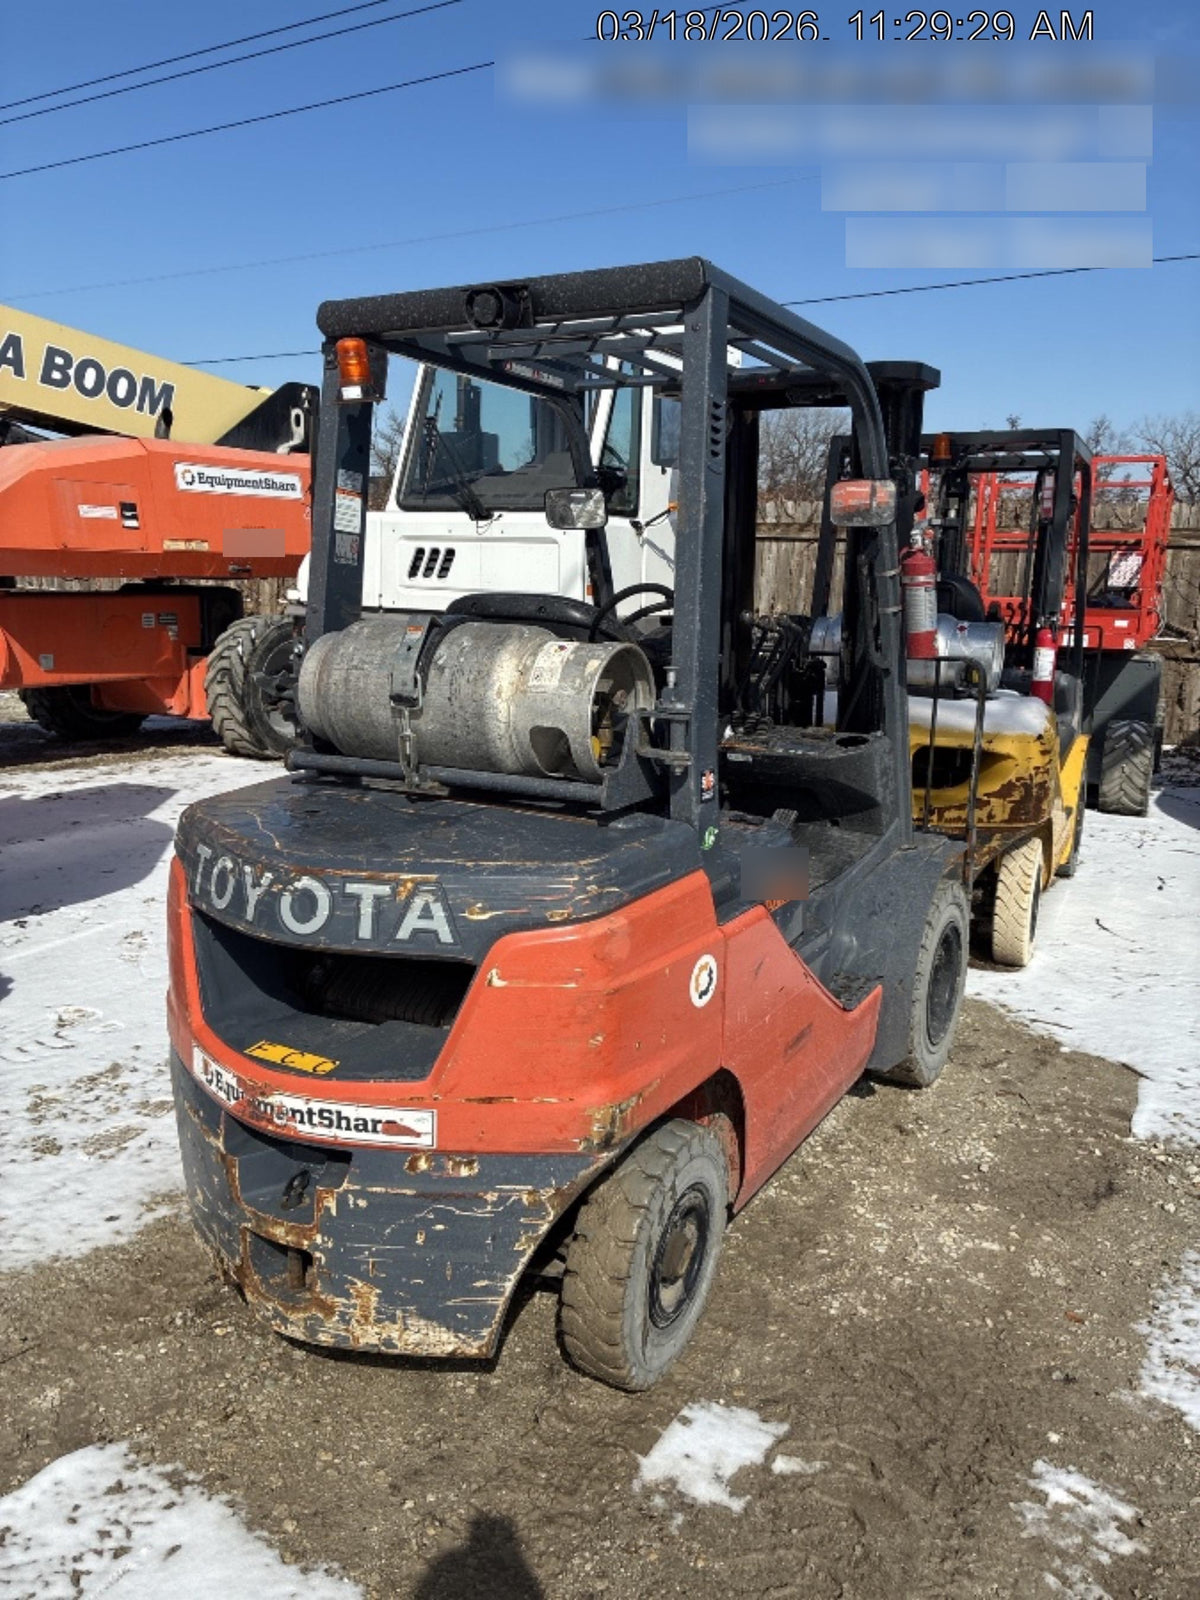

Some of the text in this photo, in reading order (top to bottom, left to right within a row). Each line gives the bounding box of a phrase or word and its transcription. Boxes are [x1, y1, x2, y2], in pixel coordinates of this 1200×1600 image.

[39, 345, 175, 416] BOOM
[196, 472, 297, 491] EquipmentShare
[194, 844, 455, 943] TOYOTA
